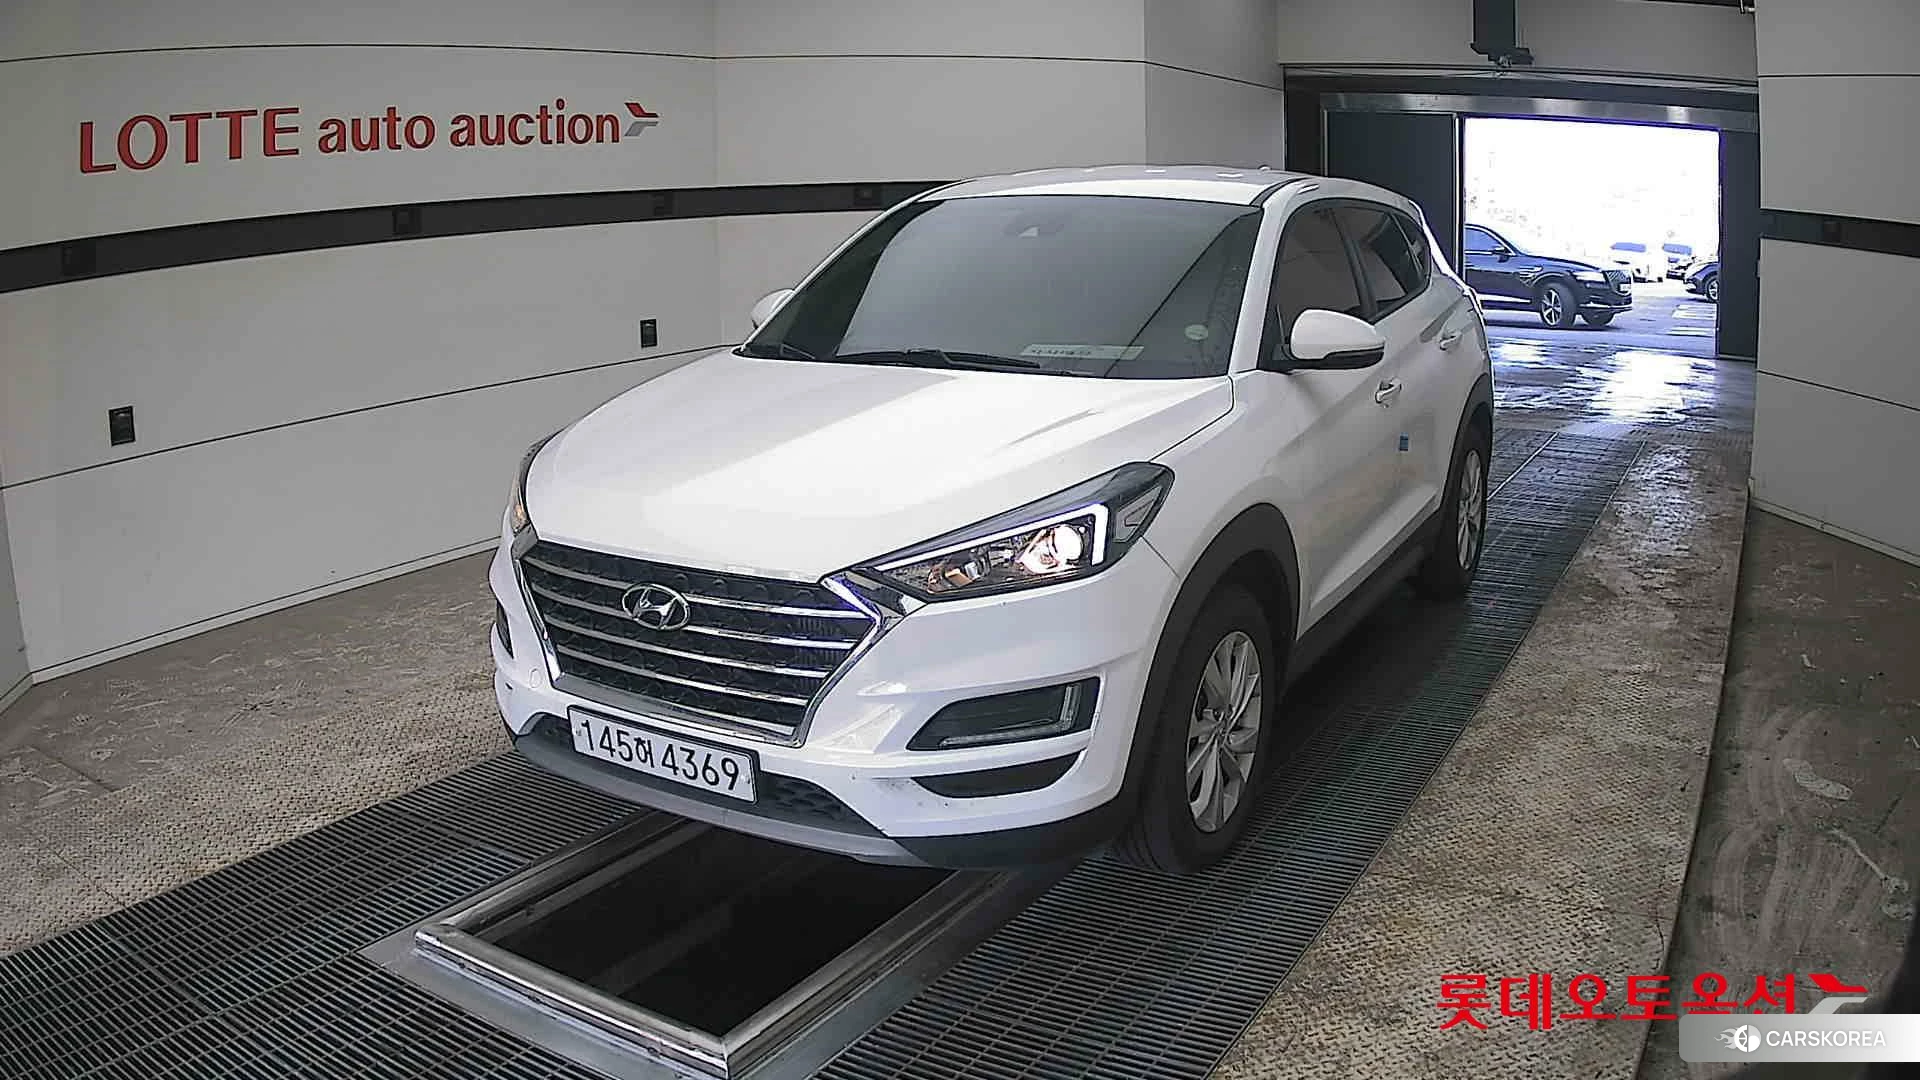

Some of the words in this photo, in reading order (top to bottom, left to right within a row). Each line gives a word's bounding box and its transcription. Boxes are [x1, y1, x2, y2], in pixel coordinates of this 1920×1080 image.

[80, 106, 300, 173] LOTTE
[318, 106, 436, 154] auto
[450, 98, 620, 147] auction
